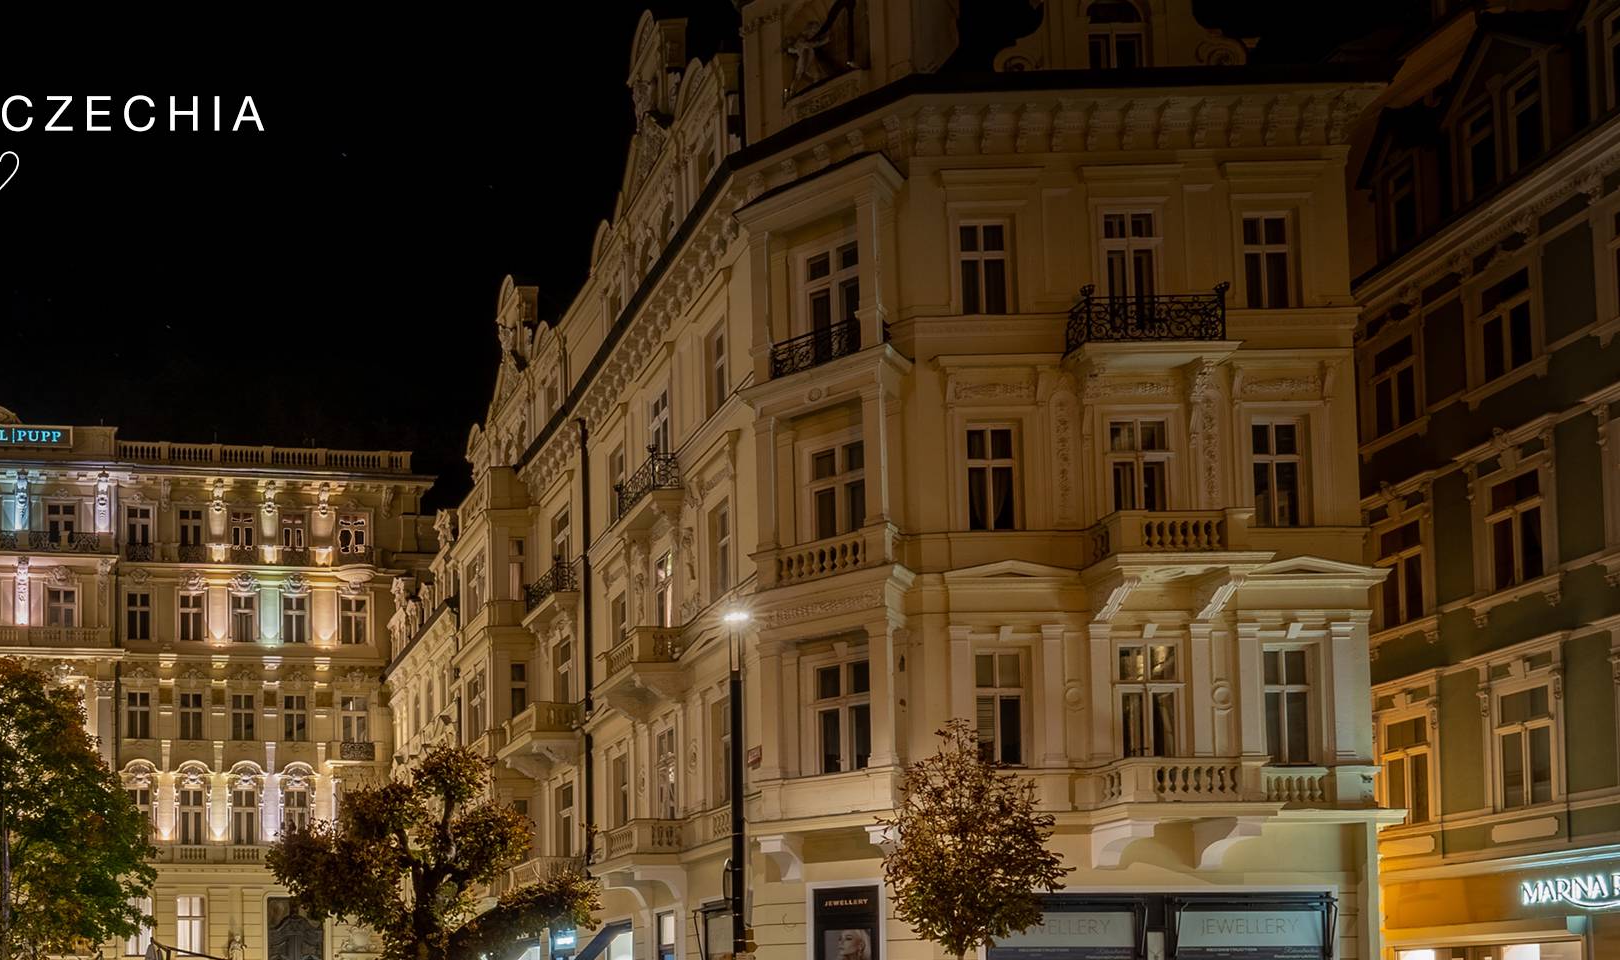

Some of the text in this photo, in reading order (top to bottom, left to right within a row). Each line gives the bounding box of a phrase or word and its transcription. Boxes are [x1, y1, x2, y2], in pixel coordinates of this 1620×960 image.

[17, 429, 62, 443] PUPP
[1521, 875, 1609, 906] MARINA
[825, 899, 868, 907] JEWELLERY
[1016, 918, 1111, 936] WELLERY
[1200, 918, 1300, 936] JEWELLERY
